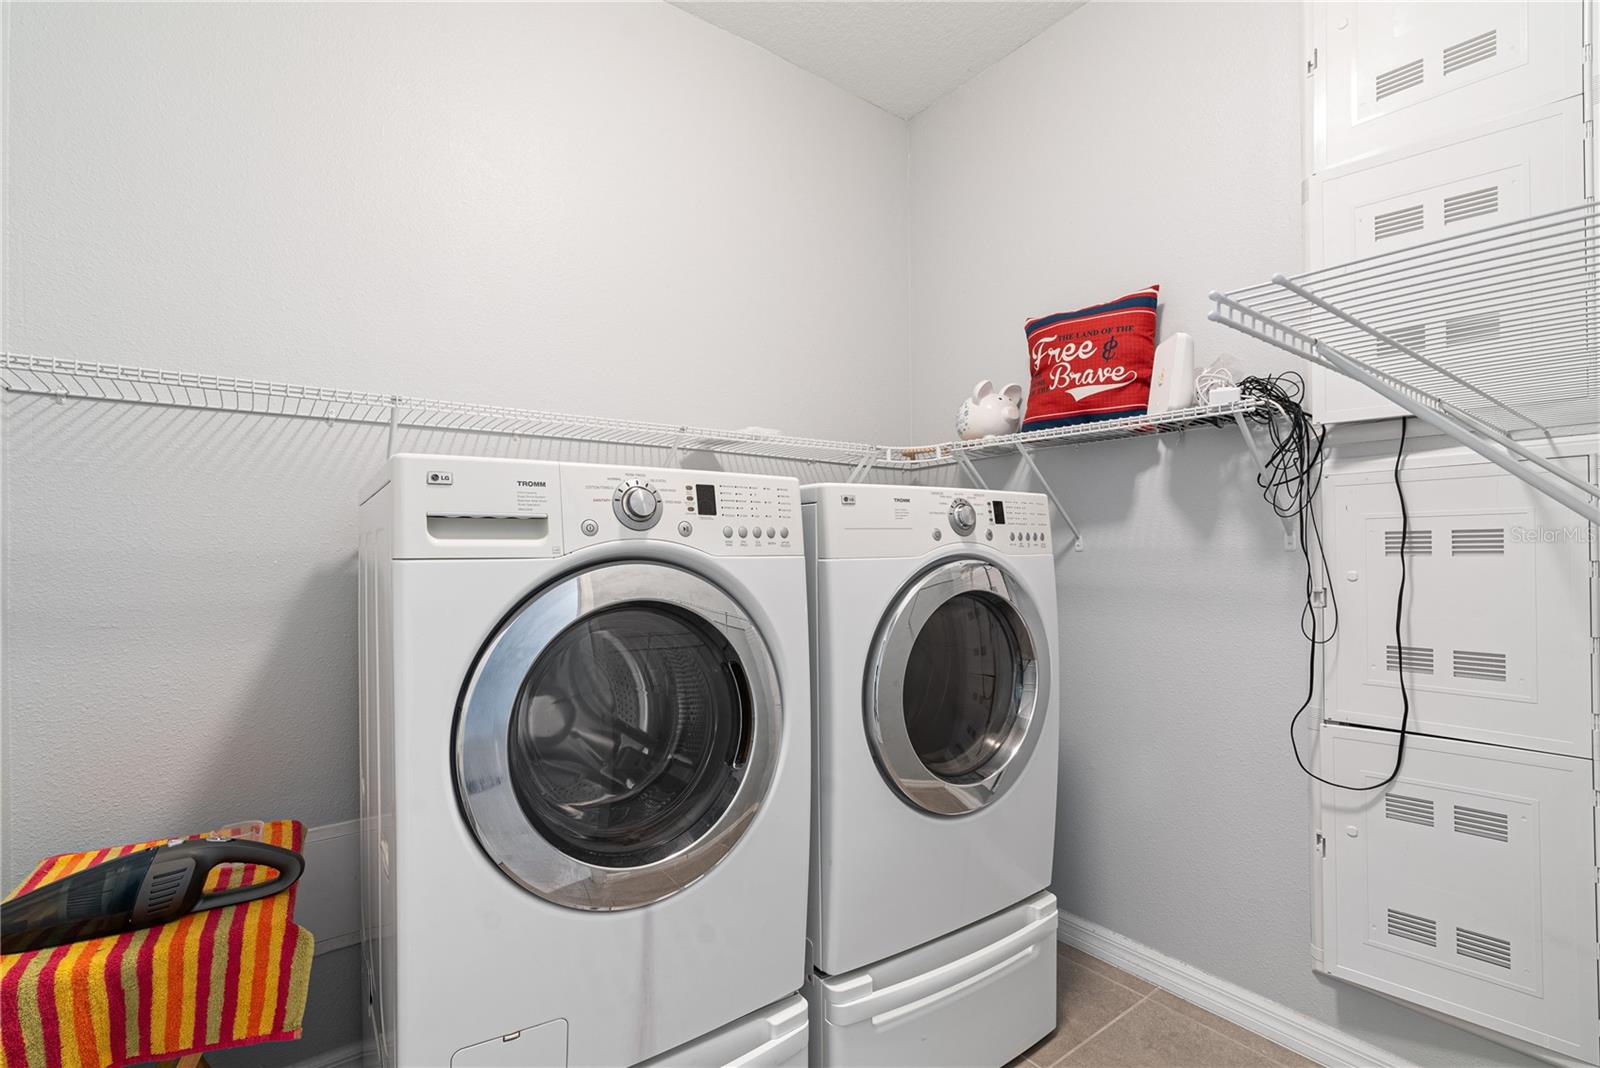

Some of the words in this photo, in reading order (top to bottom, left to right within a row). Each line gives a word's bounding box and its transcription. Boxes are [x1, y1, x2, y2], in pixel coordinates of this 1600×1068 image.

[1075, 329, 1099, 338] LAND
[1032, 334, 1098, 371] Free
[1049, 362, 1126, 390] Brave
[517, 480, 546, 488] TROMM
